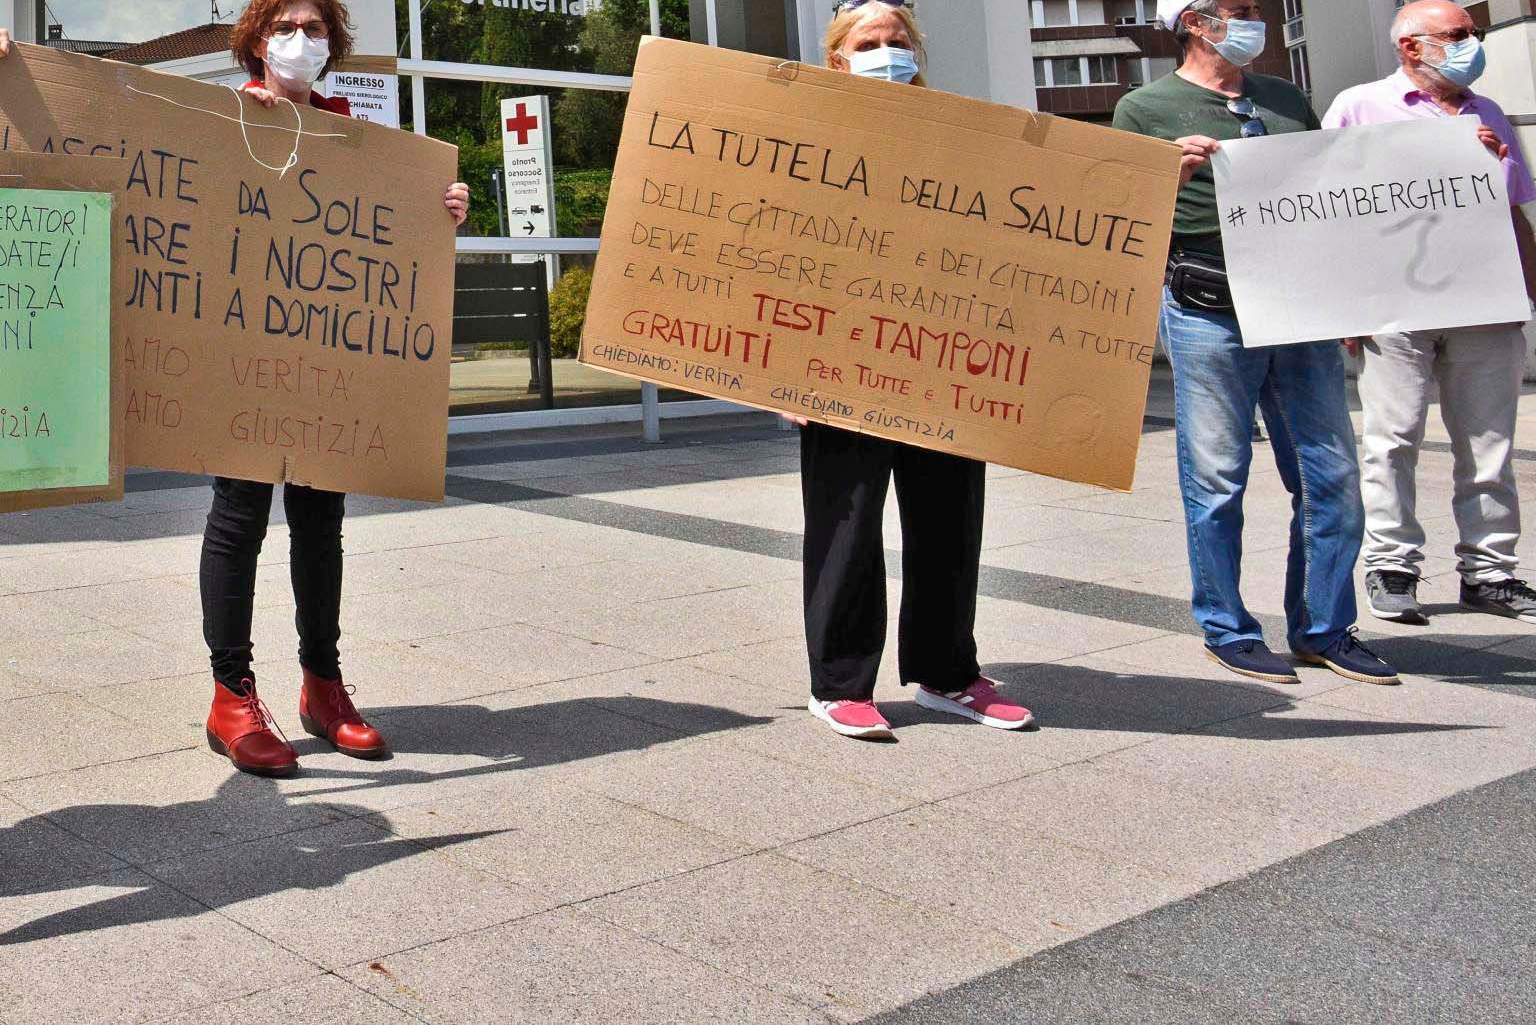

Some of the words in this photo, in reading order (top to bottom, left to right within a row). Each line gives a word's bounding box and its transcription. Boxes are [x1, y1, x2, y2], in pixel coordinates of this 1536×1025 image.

[335, 75, 385, 88] INGRESSO
[238, 180, 271, 222] DA
[293, 168, 394, 246] SOLE
[648, 111, 695, 155] LA
[711, 127, 870, 197] TUTELA
[901, 175, 987, 222] DELLA
[1003, 186, 1153, 258] SALUTE
[265, 236, 418, 313] NOSTRI
[641, 178, 723, 219] DELLE
[727, 198, 895, 259] CITTADINE
[940, 248, 982, 280] DEI
[989, 262, 1136, 316] CITTADINI
[224, 287, 246, 330] A
[264, 294, 435, 361] DOMICILIO
[623, 262, 636, 278] E
[649, 265, 664, 285] A
[672, 268, 734, 299] TUTTI
[752, 293, 837, 336] TEST
[850, 327, 864, 341] E
[870, 315, 1032, 386] TAMPONI
[631, 221, 699, 257] DEVE
[716, 242, 838, 290] ESSERE
[845, 277, 1015, 334] GARANTITA
[1049, 326, 1065, 346] A
[1078, 329, 1154, 366] TUTTE
[622, 309, 772, 369] GRATUITI
[806, 359, 844, 384] PER
[855, 363, 912, 396] TUTTE
[951, 383, 1024, 424] TUTTI
[230, 406, 388, 460] GIUSTIZIA
[770, 385, 855, 417] CHIEDIAMO
[864, 408, 955, 442] GIUSTIZIA
